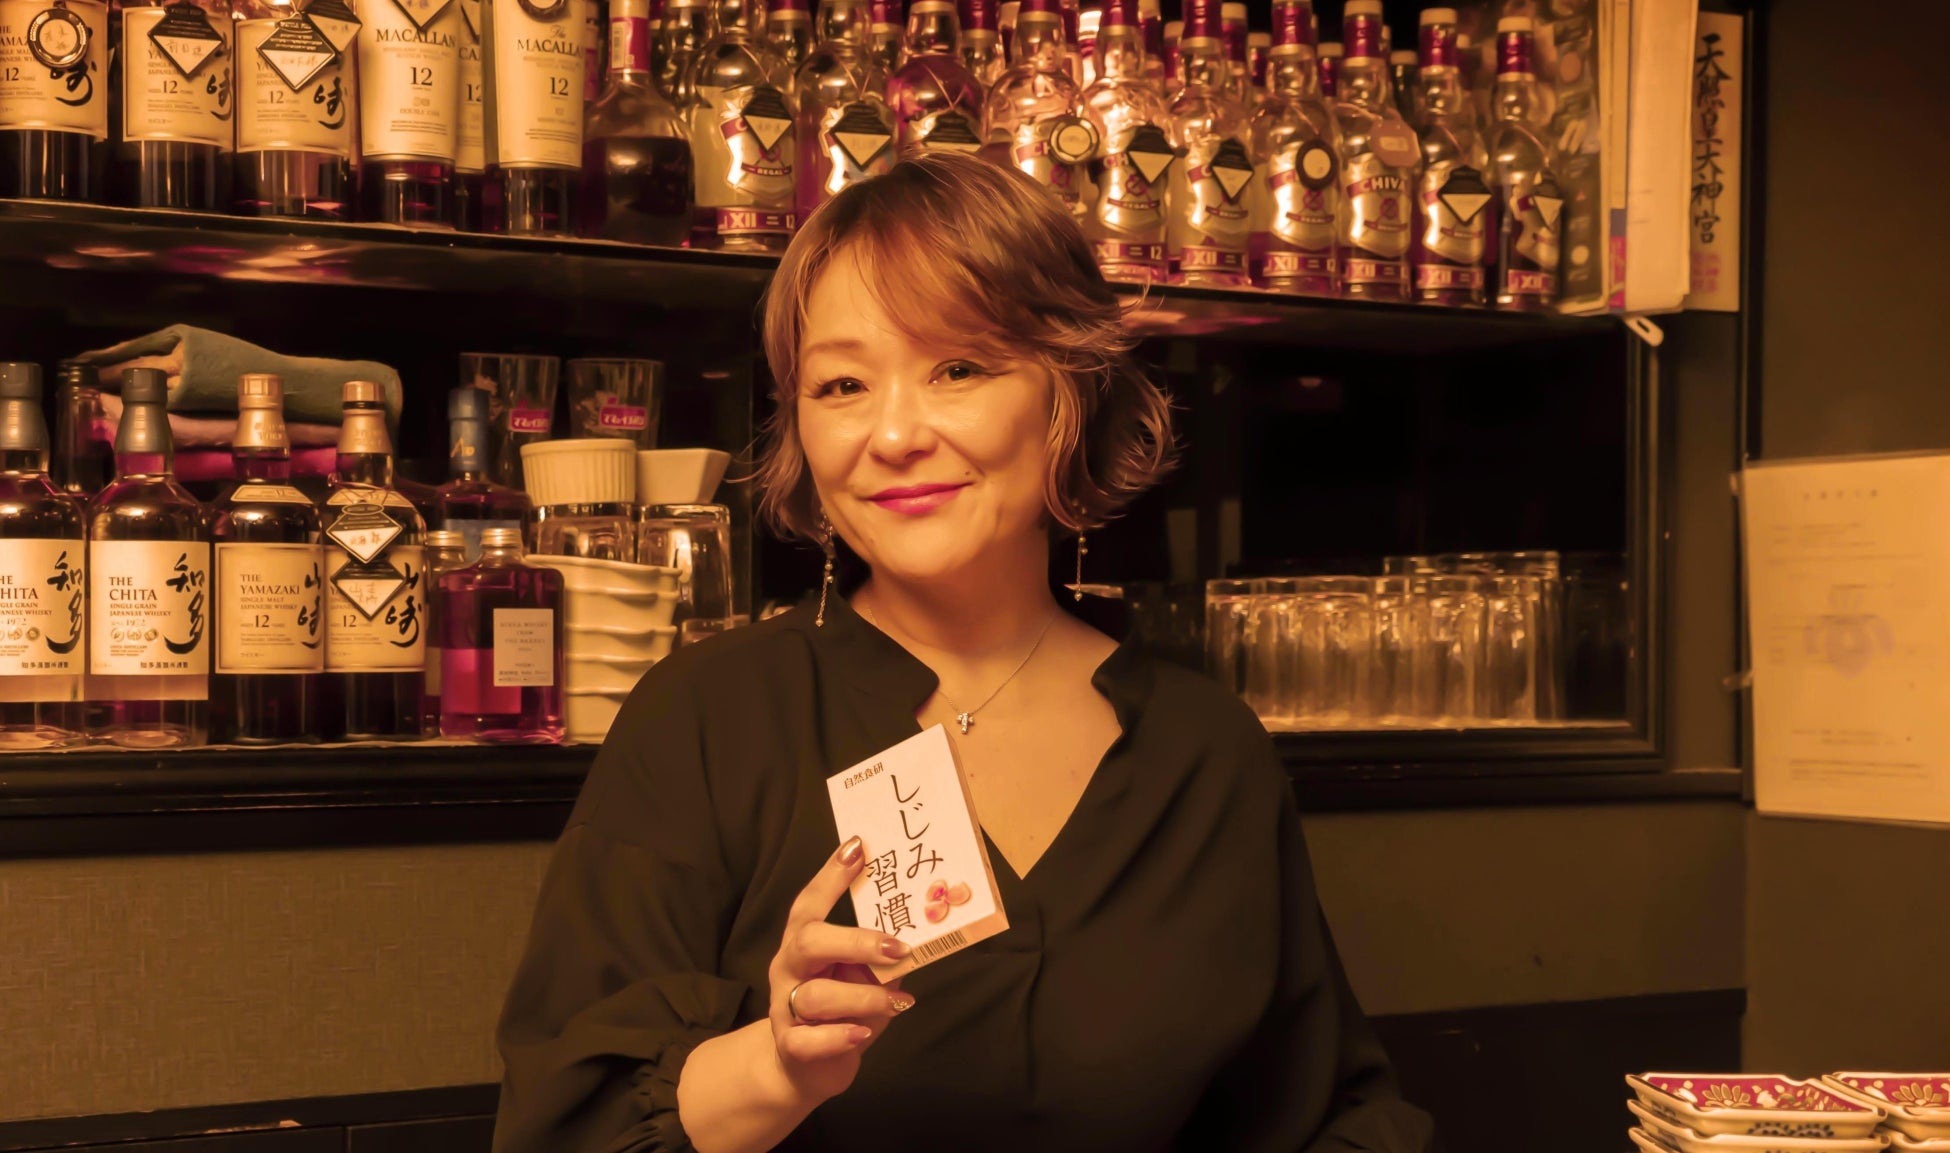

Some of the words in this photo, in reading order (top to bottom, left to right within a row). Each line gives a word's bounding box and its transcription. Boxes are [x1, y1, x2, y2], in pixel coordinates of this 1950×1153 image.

[375, 28, 457, 48] MACALLAN
[516, 39, 583, 58] MACALLA
[6, 67, 20, 81] 12
[409, 66, 433, 86] 12
[163, 80, 178, 94] 12
[549, 76, 569, 96] 12
[269, 90, 284, 104] 12
[1694, 33, 1731, 244] 天照皇大神宮
[757, 168, 782, 176] REGAL
[1360, 176, 1405, 191] CHIVA
[730, 213, 756, 229] XII
[1150, 246, 1162, 260] 12
[1274, 256, 1298, 271] XII
[0, 575, 13, 585] HE
[109, 576, 133, 587] THE
[240, 573, 260, 582] THE
[0, 587, 39, 600] HITA
[109, 588, 158, 601] CHITA
[240, 584, 300, 595] YAMAZAKI
[134, 602, 158, 610] GRAIN
[165, 552, 205, 654] 知多
[25, 609, 53, 617] WHISKY
[255, 614, 270, 628] 12
[343, 614, 358, 628] 12
[844, 762, 884, 790] 自然食研
[890, 774, 944, 879] しじみ
[865, 850, 916, 936] 習慣
